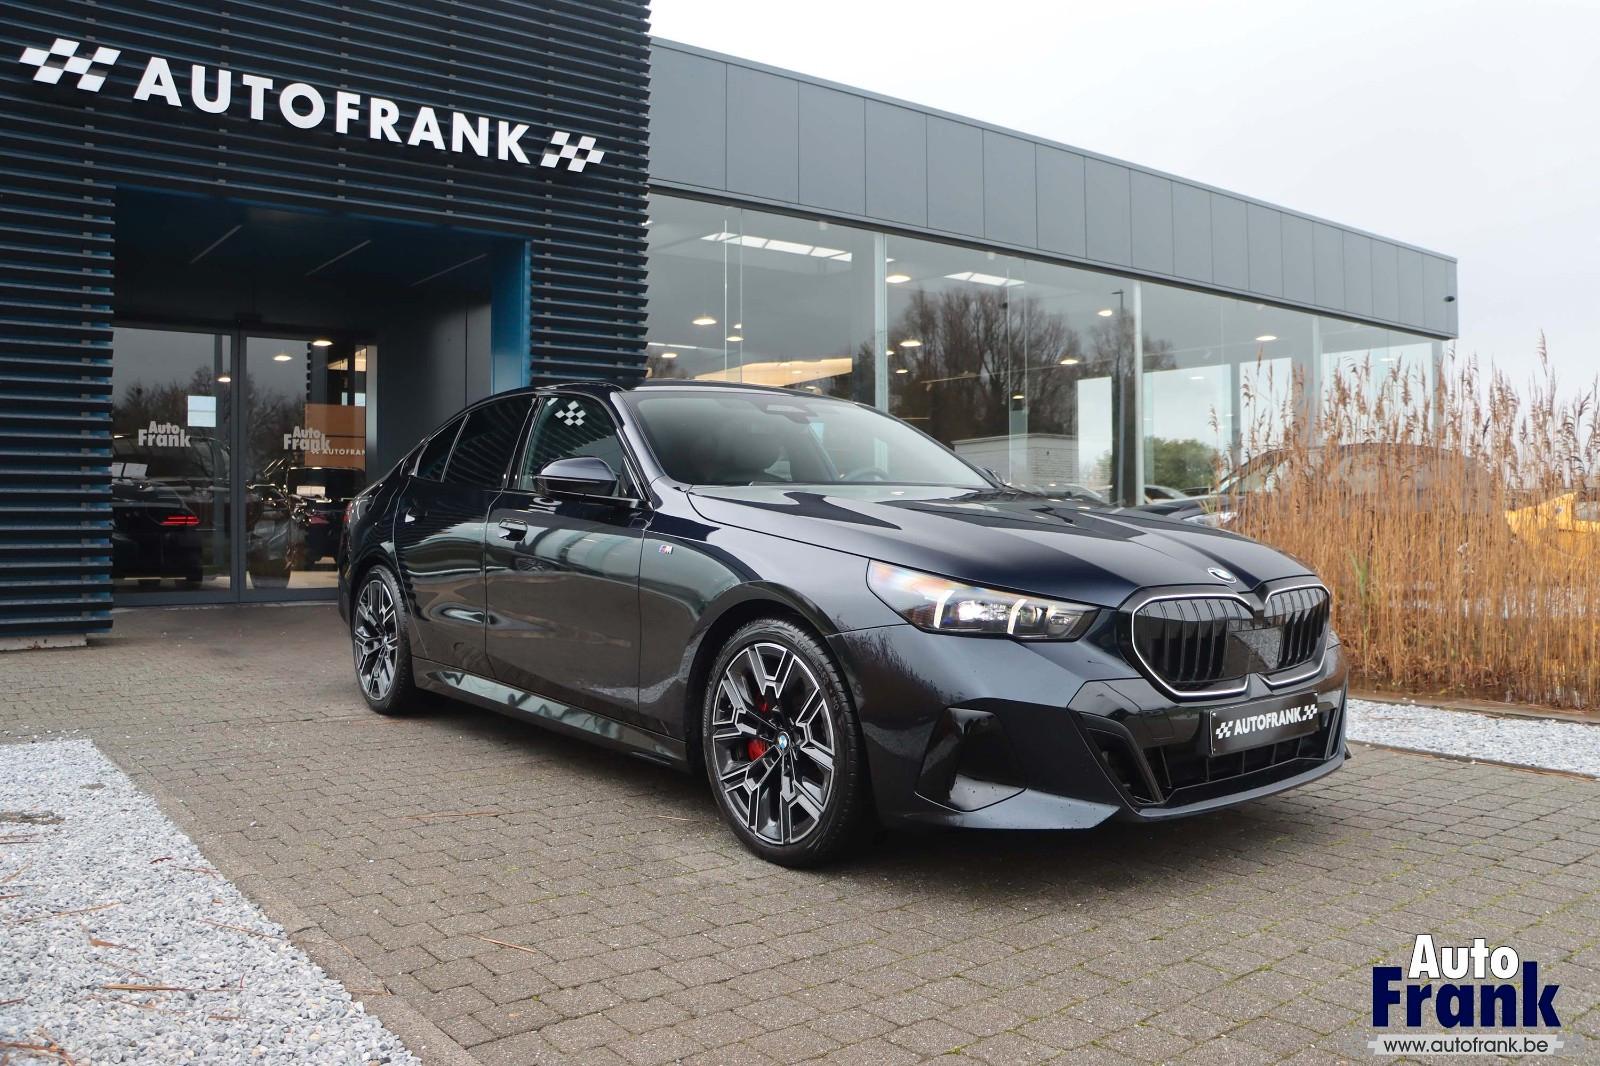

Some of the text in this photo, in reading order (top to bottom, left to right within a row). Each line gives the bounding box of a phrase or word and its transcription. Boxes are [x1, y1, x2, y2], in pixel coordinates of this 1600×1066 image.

[133, 57, 531, 164] AUTOFRANK
[149, 421, 180, 435] Auto
[292, 426, 321, 439] Auto
[138, 428, 191, 448] Frank
[283, 432, 331, 451] Frank
[1233, 706, 1302, 736] AUTOFRANK
